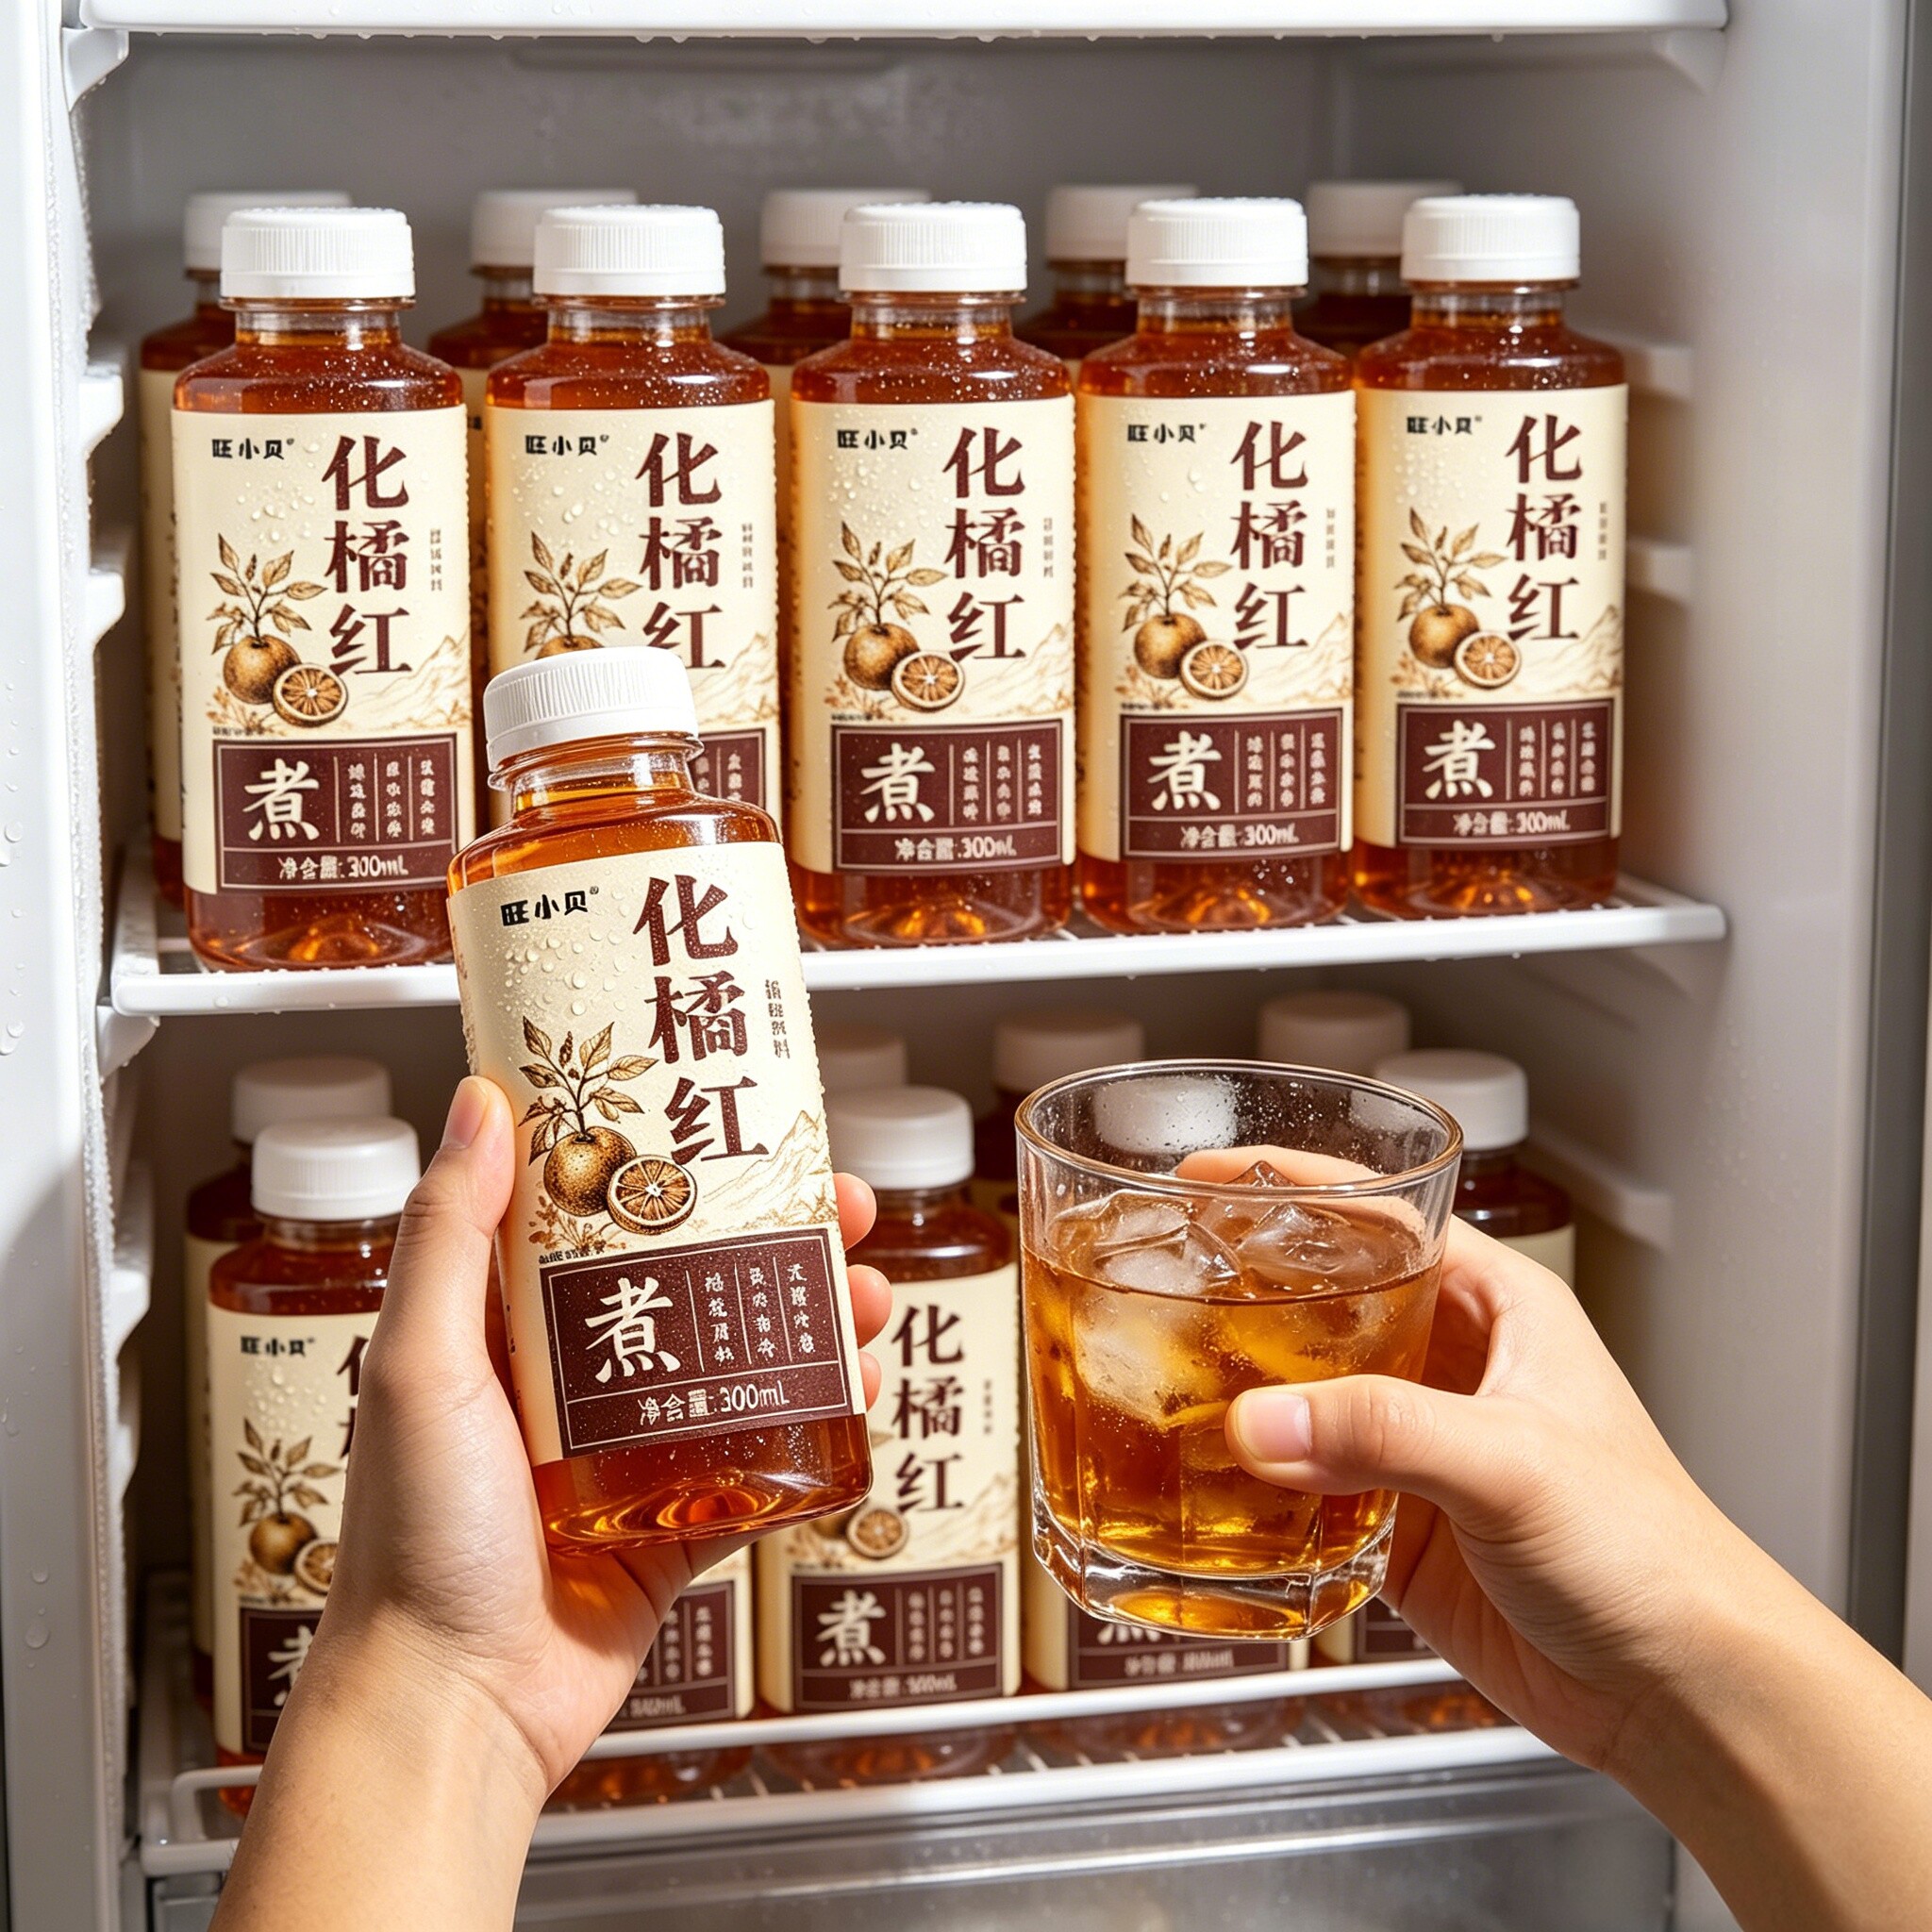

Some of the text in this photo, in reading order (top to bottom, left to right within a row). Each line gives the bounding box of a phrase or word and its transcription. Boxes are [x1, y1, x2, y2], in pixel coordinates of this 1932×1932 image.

[211, 438, 284, 460] 旺小贝
[525, 434, 597, 457] 旺小贝
[321, 435, 412, 675] 化橘红
[635, 432, 725, 670] 化橘红
[942, 427, 1025, 660] 化橘红
[1230, 421, 1308, 651] 化橘红
[1506, 414, 1582, 641] 化橘红
[242, 758, 320, 841] 煮
[861, 742, 935, 823] 煮
[1147, 730, 1222, 811] 煮
[1423, 720, 1496, 799] 煮
[500, 890, 589, 927] 旺小贝
[633, 874, 770, 1165] 化橘红
[584, 1276, 681, 1384] 煮
[891, 1304, 966, 1516] 化橘红
[816, 1589, 887, 1667] 煮
